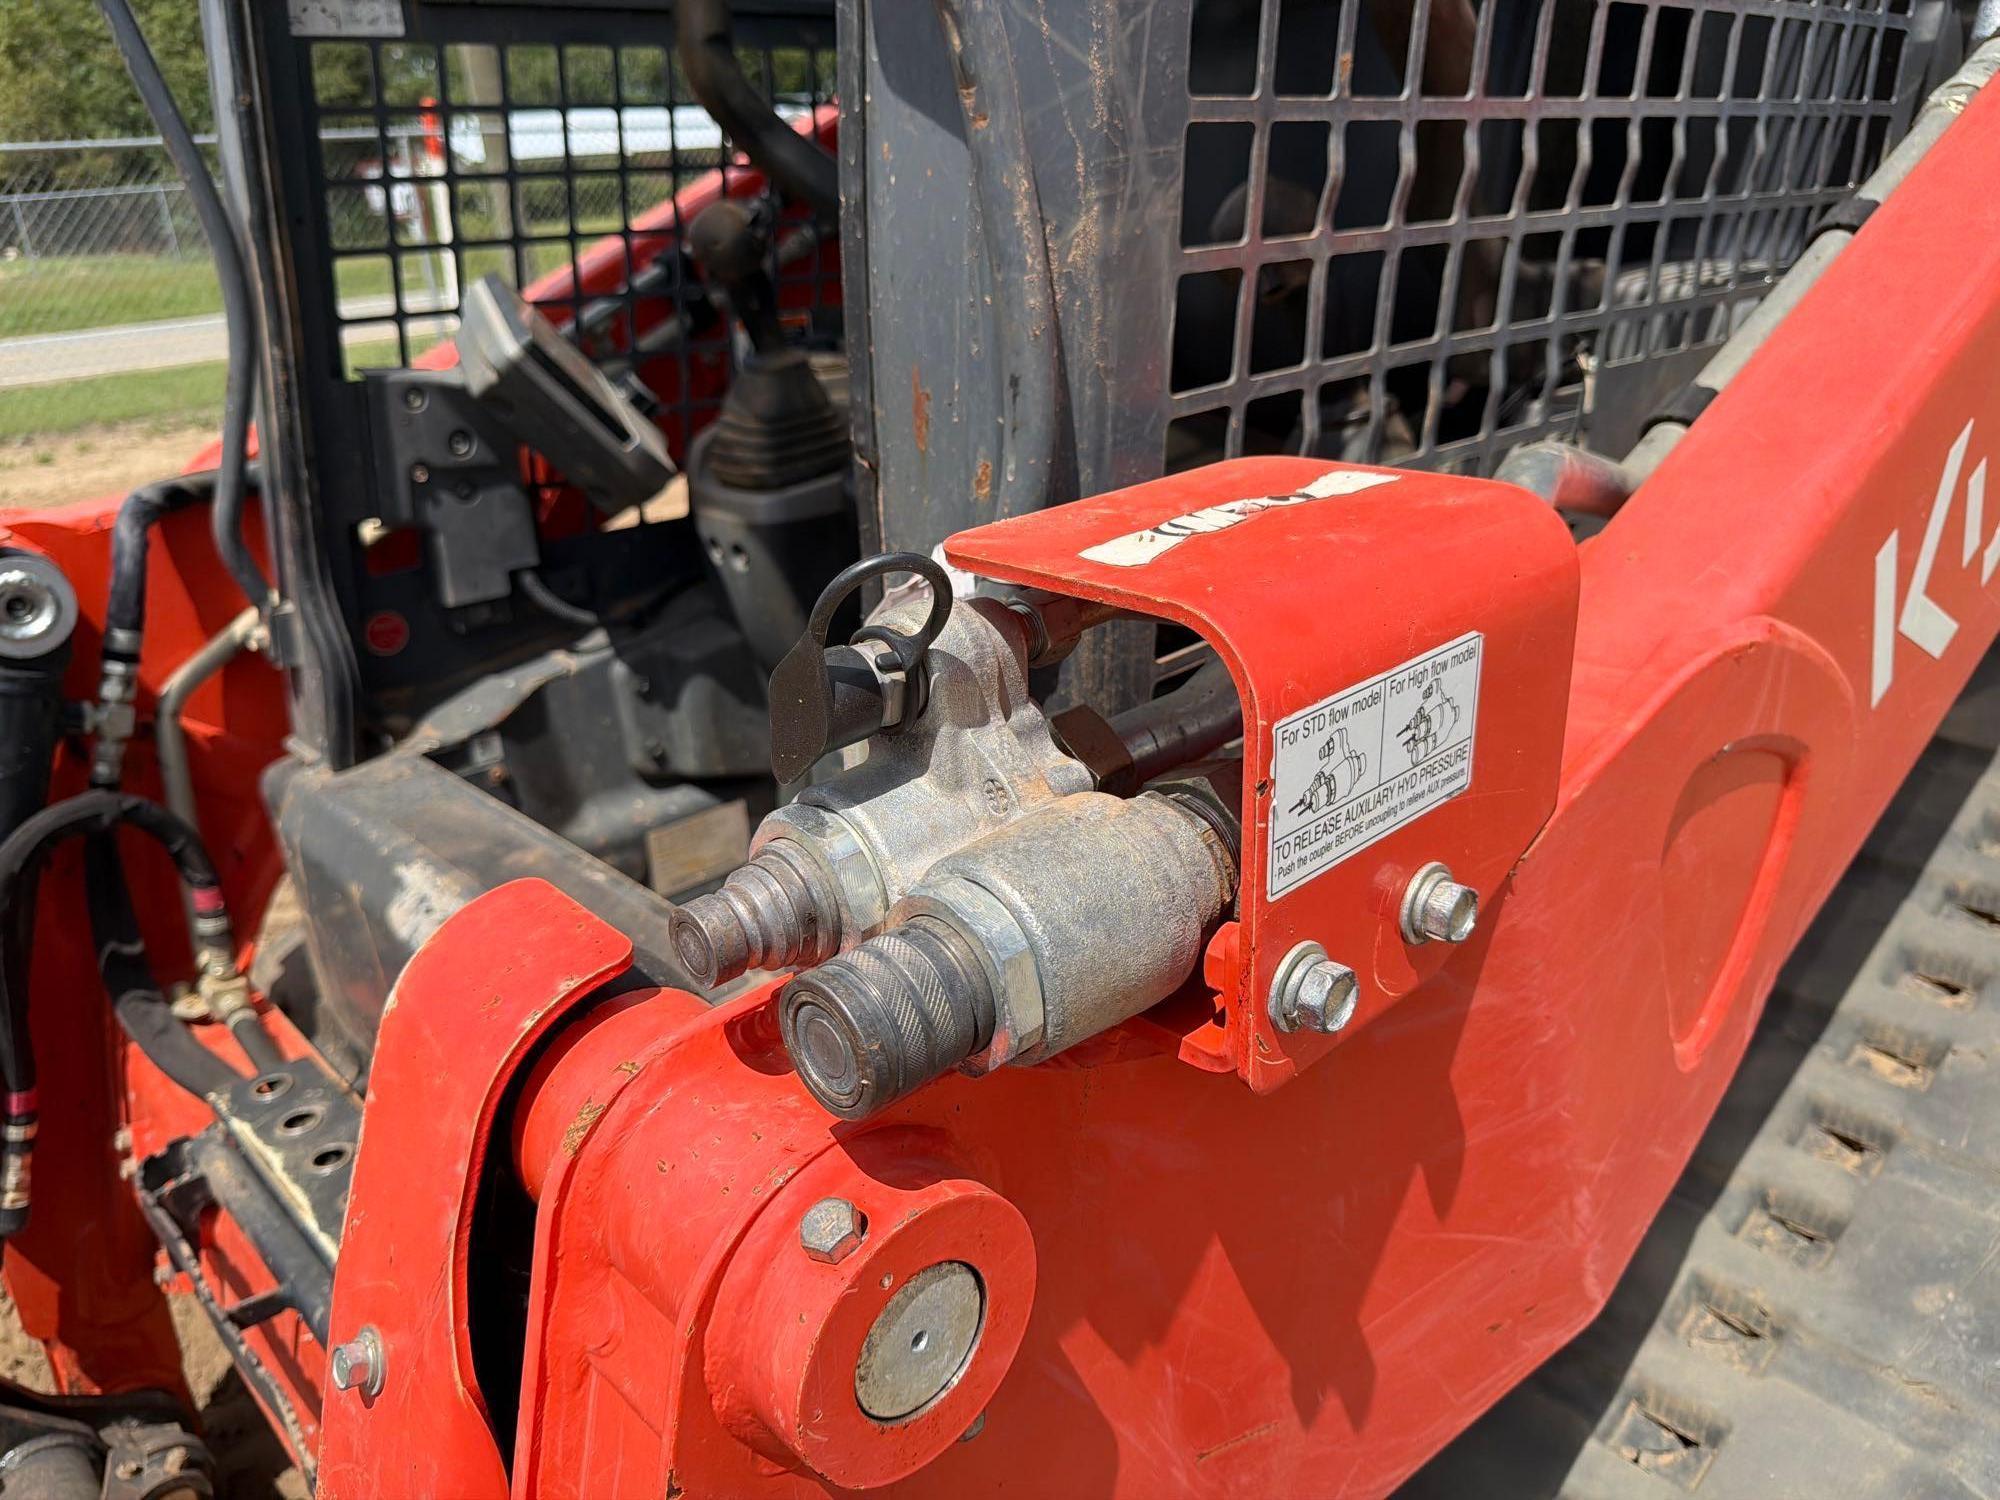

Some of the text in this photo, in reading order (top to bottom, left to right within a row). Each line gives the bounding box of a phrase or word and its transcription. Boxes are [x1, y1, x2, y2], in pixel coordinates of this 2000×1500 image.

[1390, 640, 1477, 698] For High flow model
[1281, 685, 1382, 749] For STD flow model
[1275, 744, 1468, 863] TO RELEASE AUXILIARY HYD PRESSURE
[1297, 855, 1308, 869] the
[1309, 841, 1333, 862] coupler
[1334, 820, 1364, 848] BEFORE
[1365, 804, 1398, 830] uncoupling
[1399, 800, 1406, 812] to
[1407, 789, 1426, 806] relieve
[1427, 779, 1441, 796] AUX
